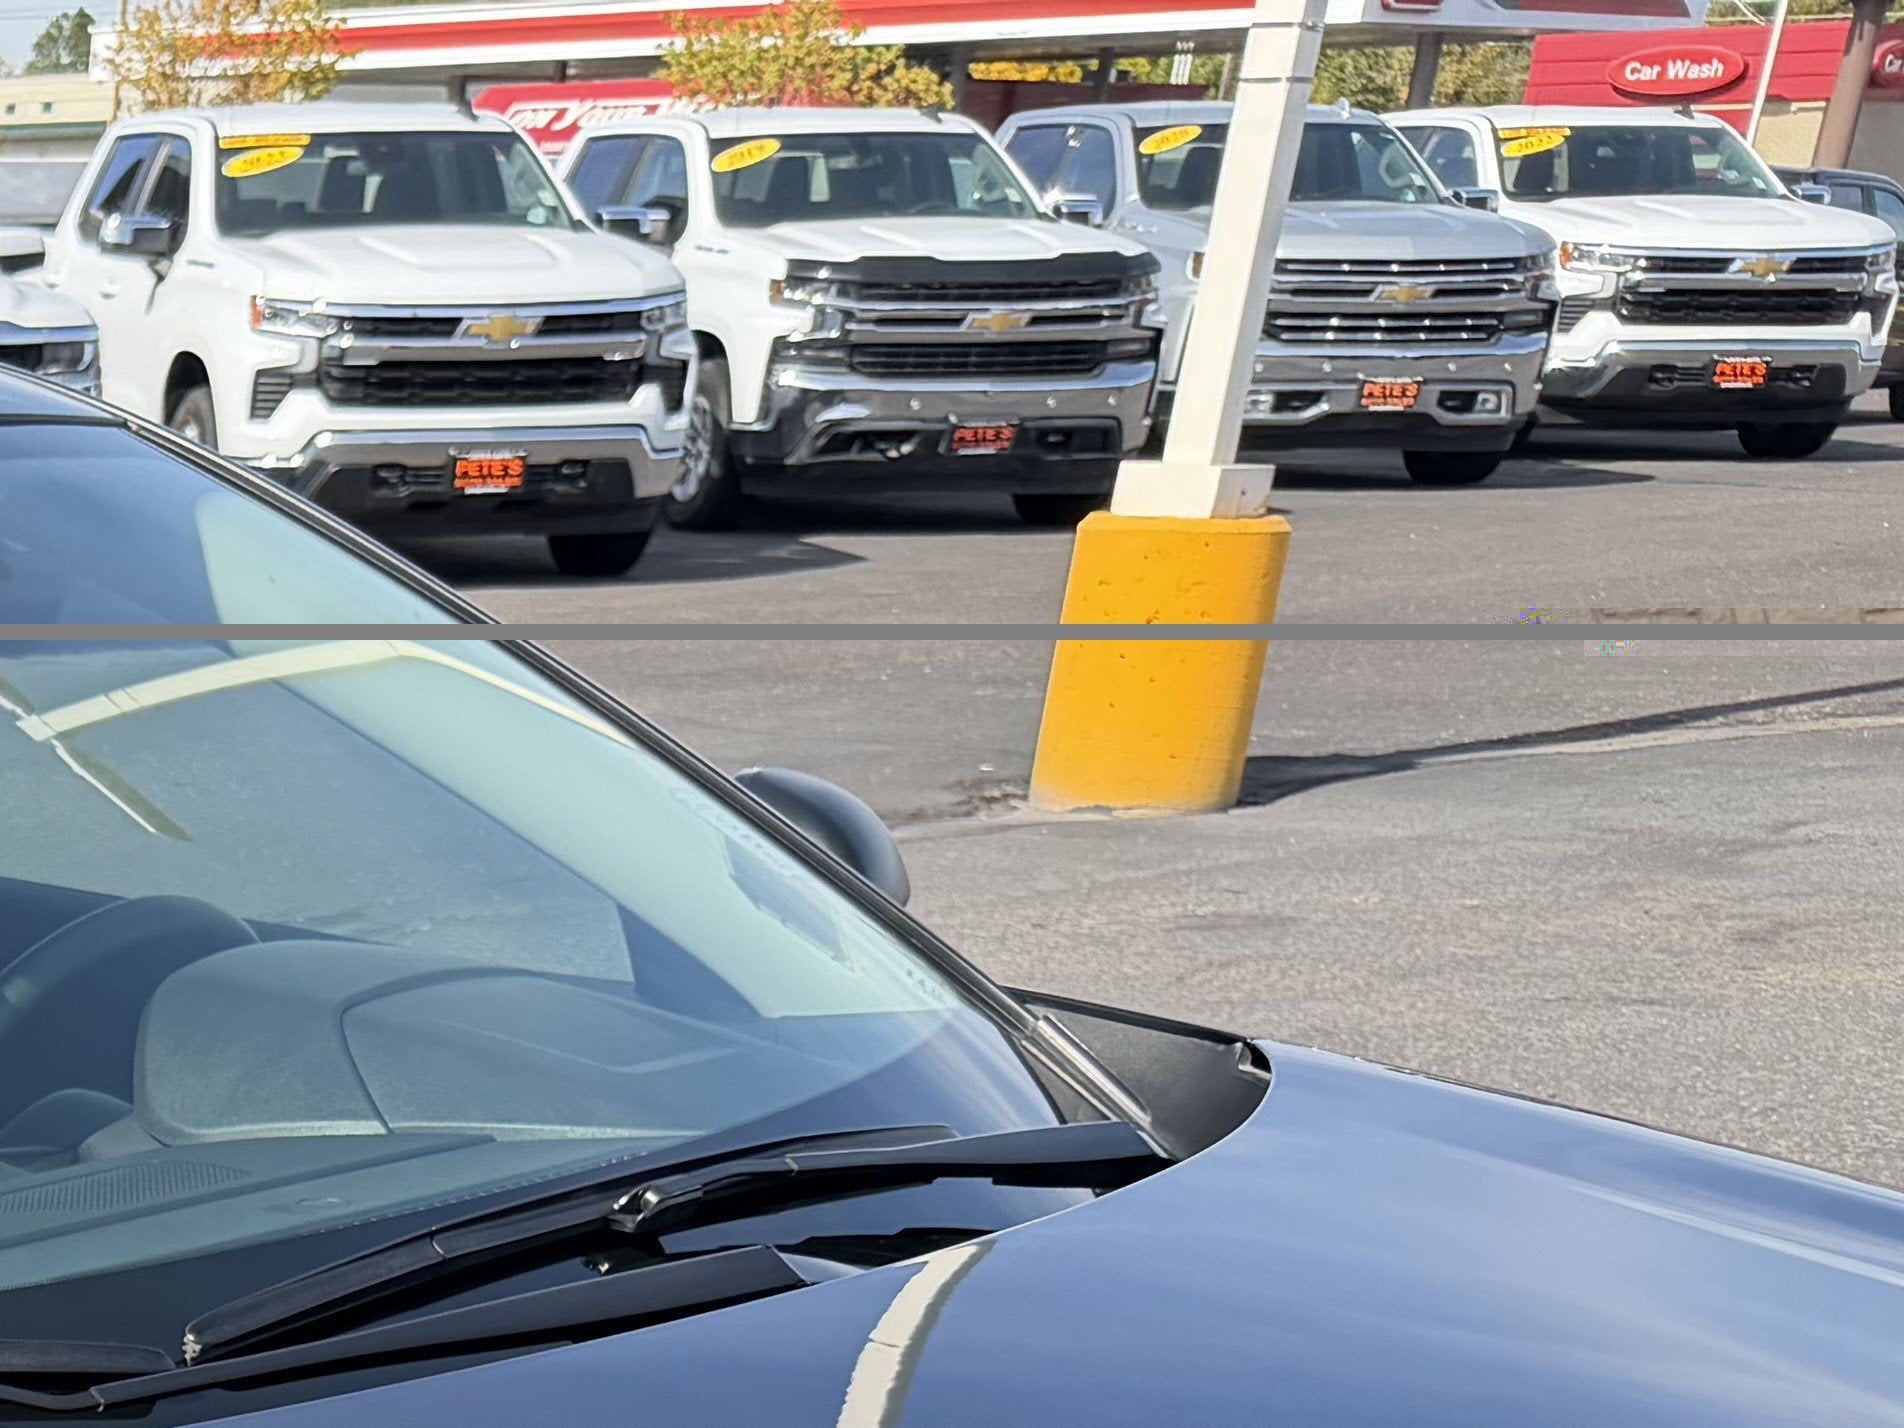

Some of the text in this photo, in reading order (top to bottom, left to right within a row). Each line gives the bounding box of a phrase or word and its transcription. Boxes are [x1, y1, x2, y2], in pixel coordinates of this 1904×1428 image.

[1625, 57, 1725, 81] Car Wash
[1884, 53, 1904, 73] Ca
